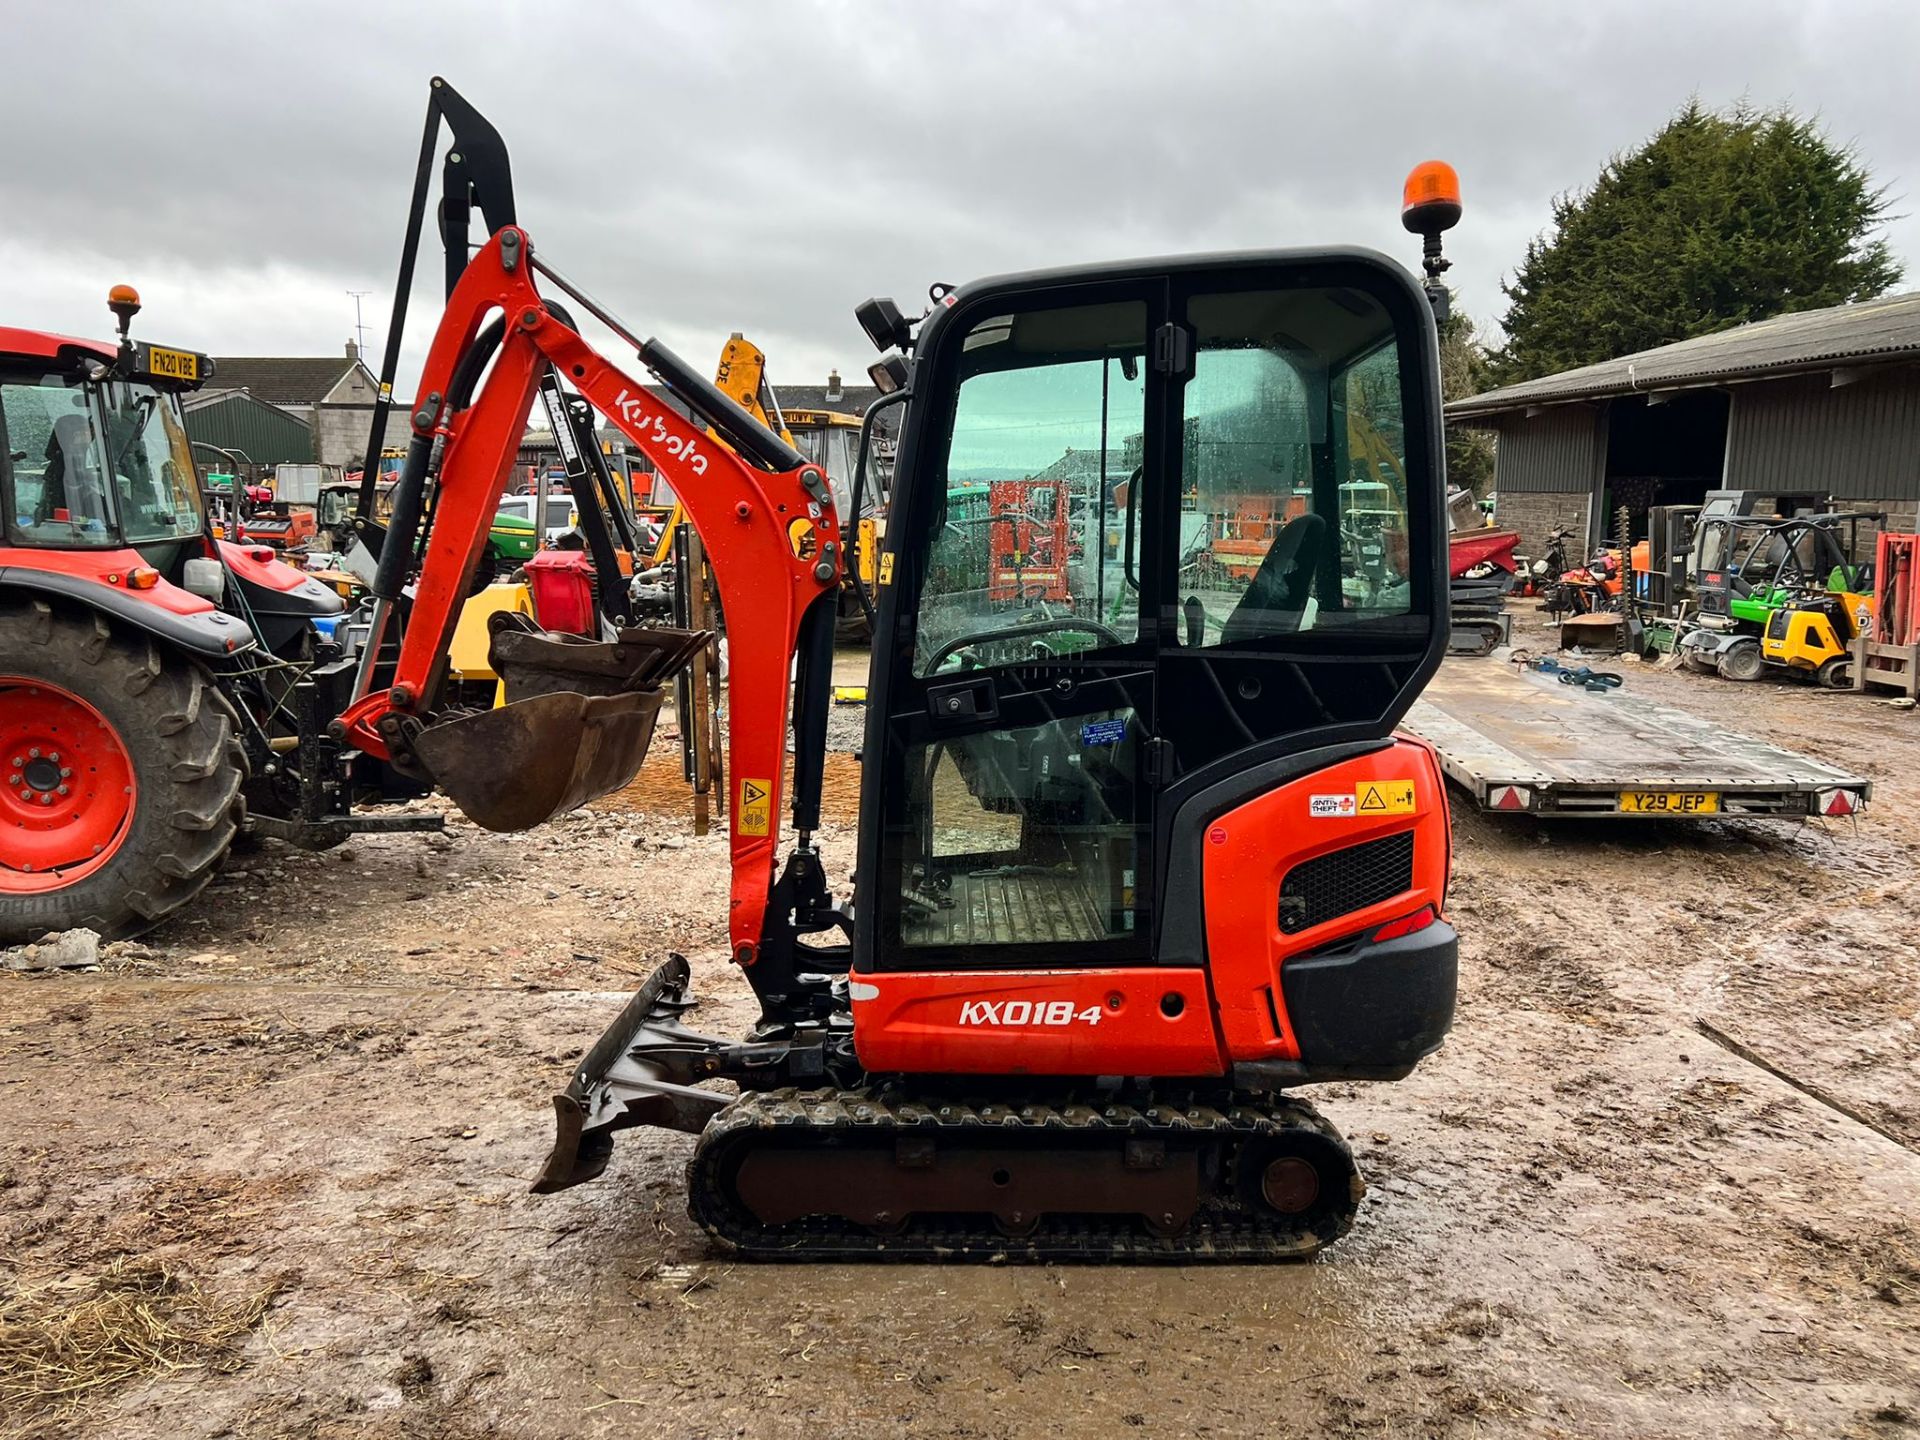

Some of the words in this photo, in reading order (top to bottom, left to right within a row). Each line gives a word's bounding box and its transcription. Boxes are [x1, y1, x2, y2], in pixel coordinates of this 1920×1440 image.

[154, 352, 176, 373] FN20
[177, 355, 193, 376] VBE
[717, 361, 731, 384] 3CX
[614, 389, 708, 476] Kubota
[1634, 793, 1668, 811] Y29
[1672, 794, 1705, 810] JEP
[958, 1001, 1102, 1025] KX018-4
